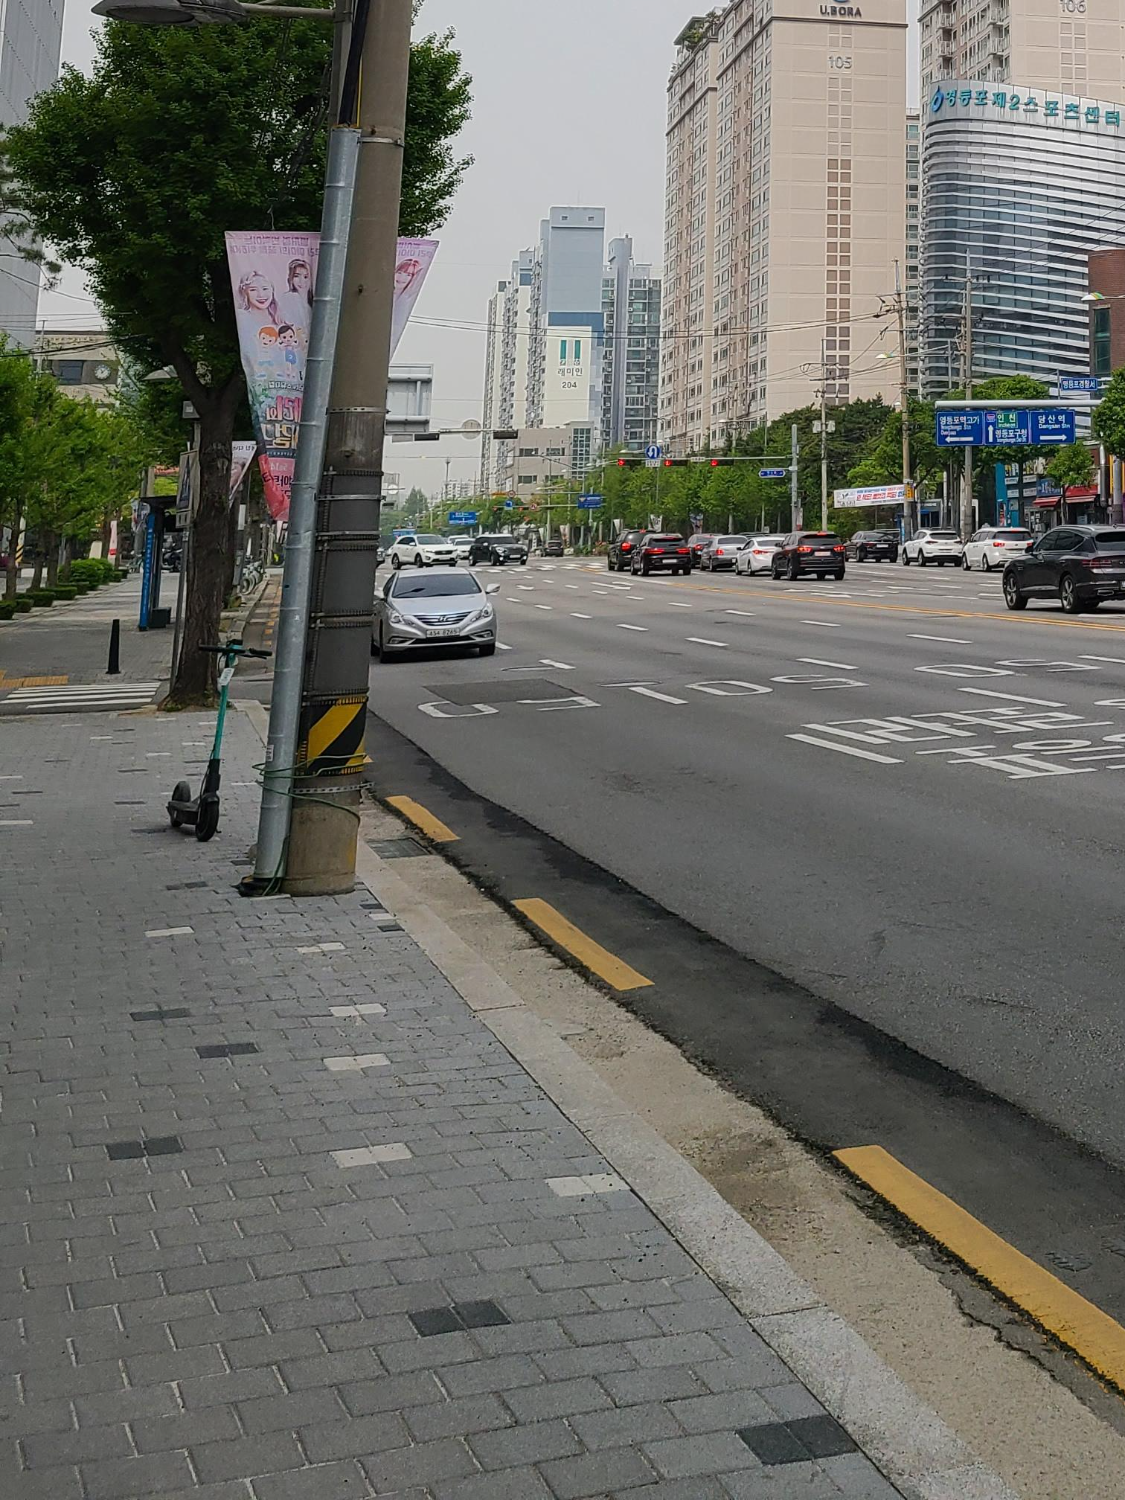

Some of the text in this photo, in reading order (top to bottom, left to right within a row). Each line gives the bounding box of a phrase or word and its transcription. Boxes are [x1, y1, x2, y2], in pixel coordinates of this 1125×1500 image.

[820, 4, 862, 18] U.BORA
[828, 56, 852, 70] 105
[945, 89, 1121, 127] 영등포제2스포츠센터
[562, 381, 577, 389] 204
[914, 659, 1102, 678] 50
[686, 674, 869, 696] 50
